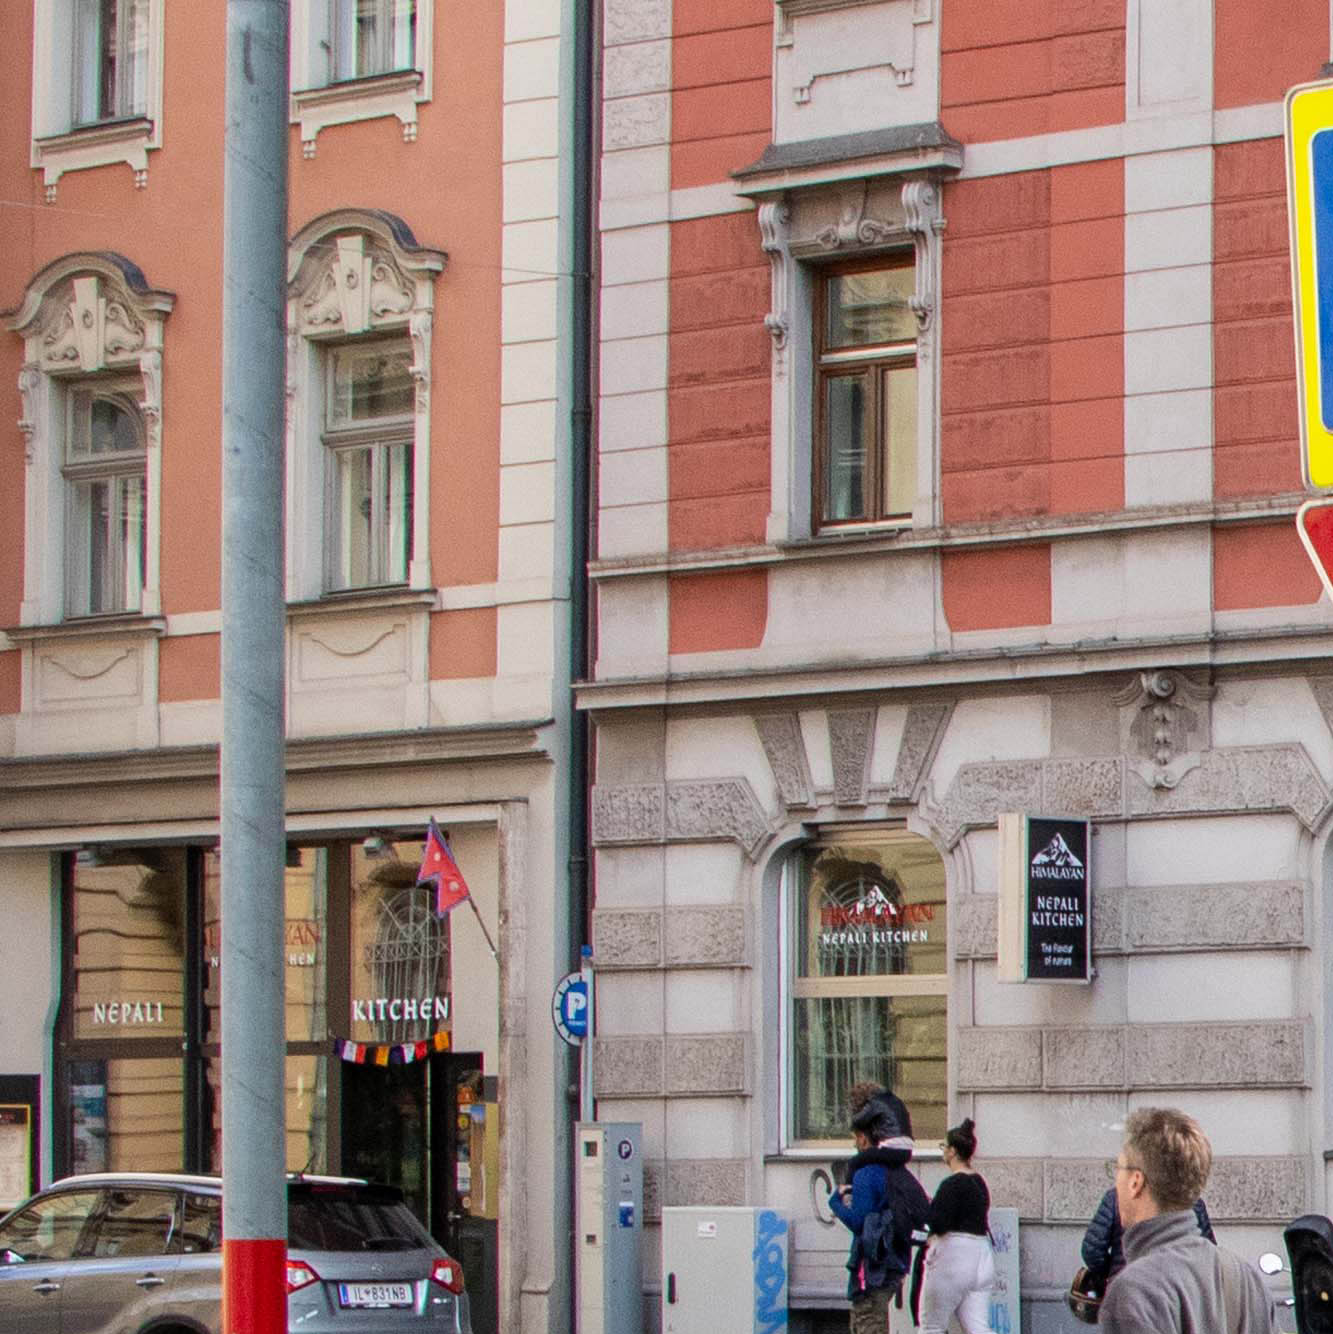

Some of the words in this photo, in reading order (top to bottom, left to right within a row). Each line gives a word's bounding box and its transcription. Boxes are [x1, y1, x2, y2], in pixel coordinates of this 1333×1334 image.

[1031, 866, 1085, 879] HIMALAYAN
[1037, 896, 1079, 911] NEPALI
[1032, 911, 1084, 926] KITCHEN
[822, 931, 867, 944] NEPALI
[872, 929, 929, 943] KITCHEN
[93, 1002, 164, 1024] NEPALI
[352, 997, 450, 1021] KITCHEN
